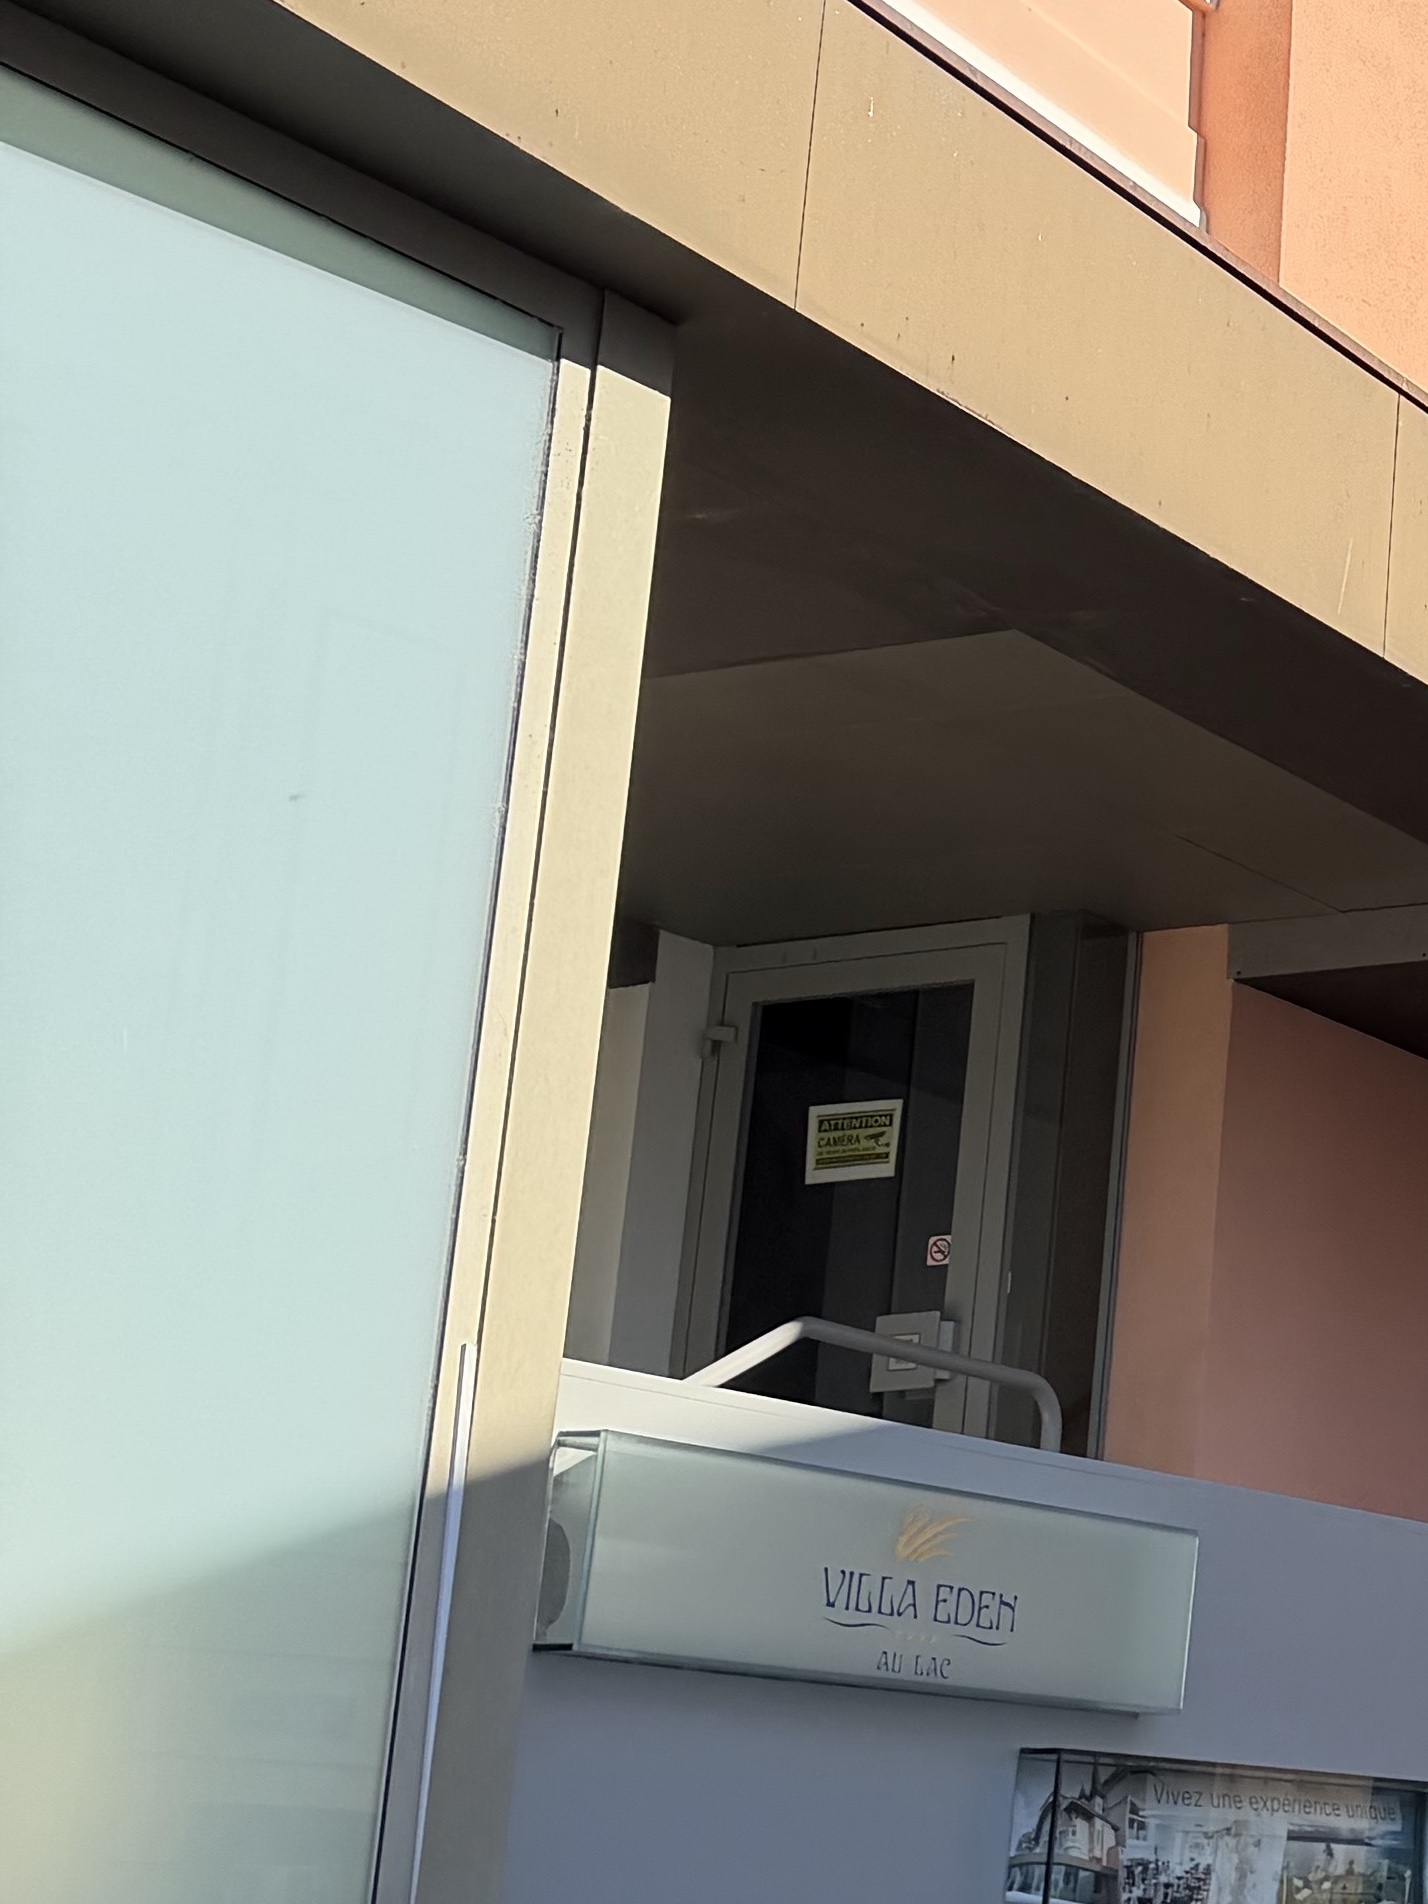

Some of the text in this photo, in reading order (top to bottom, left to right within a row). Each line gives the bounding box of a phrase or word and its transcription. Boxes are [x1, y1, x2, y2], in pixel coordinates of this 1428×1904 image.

[819, 1115, 891, 1132] ATTENTION
[823, 1566, 1018, 1632] VILLA EDEN
[876, 1651, 951, 1679] AU LAC
[1153, 1783, 1396, 1825] Vivez une expérience unique
